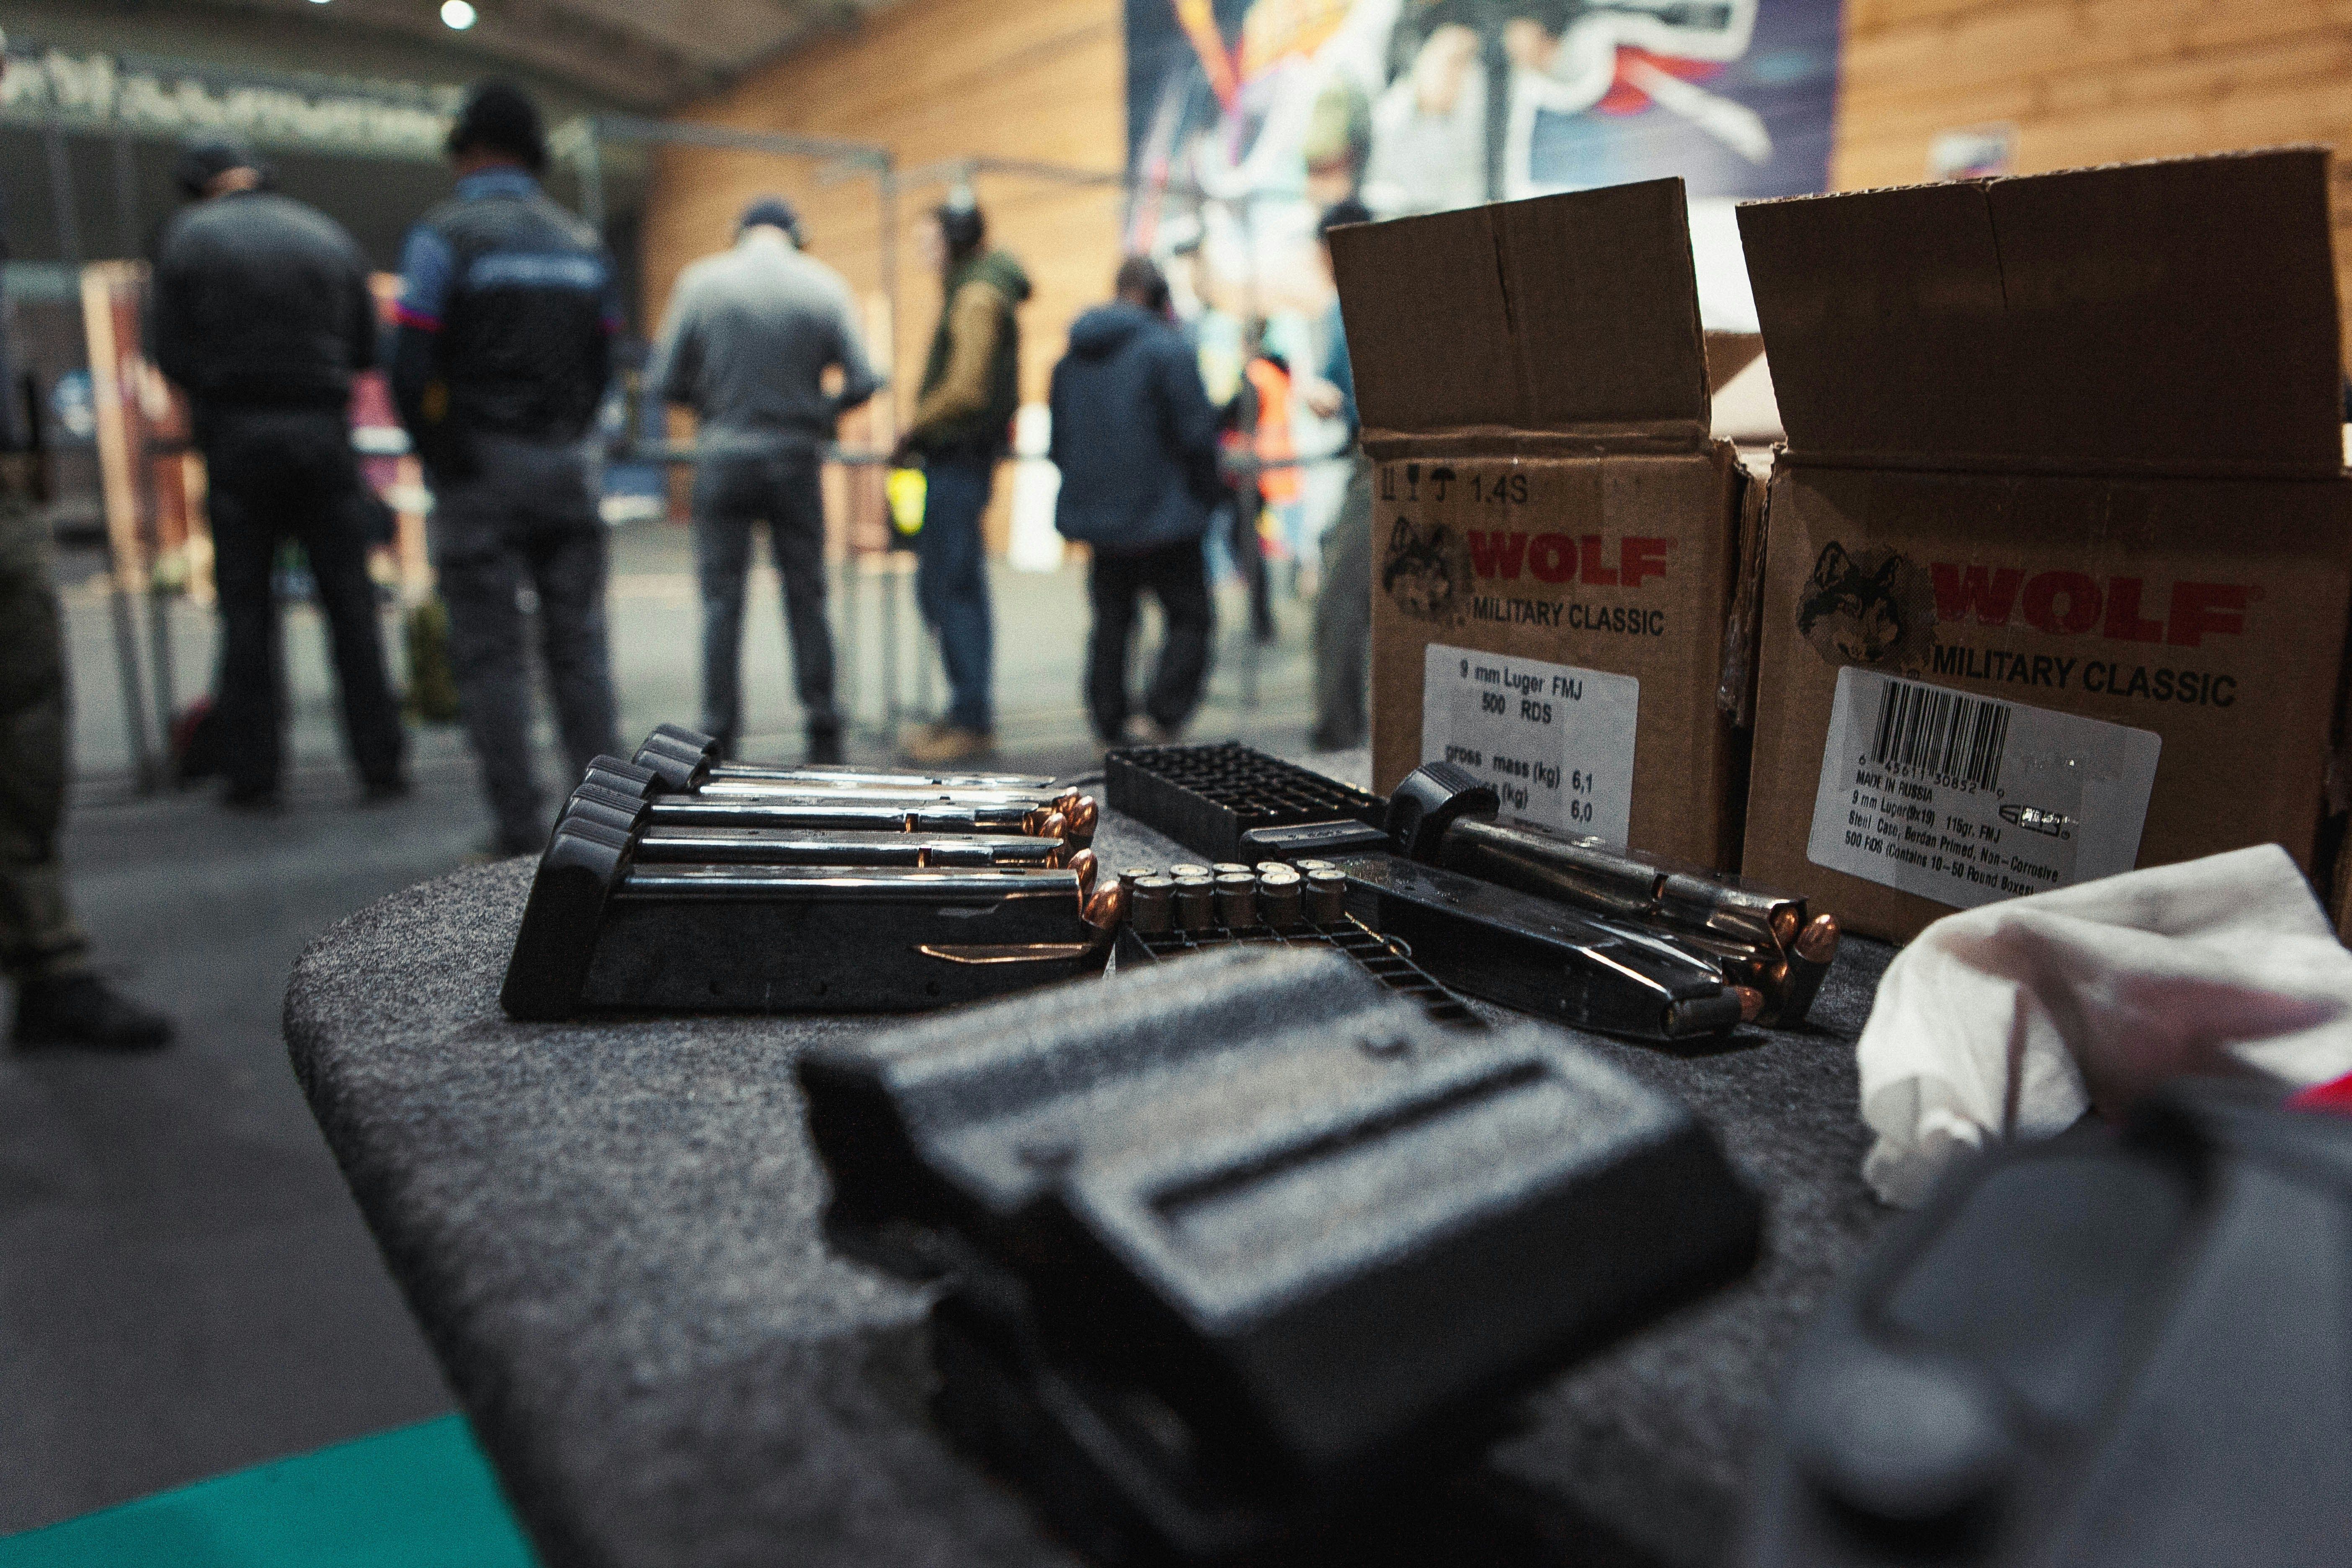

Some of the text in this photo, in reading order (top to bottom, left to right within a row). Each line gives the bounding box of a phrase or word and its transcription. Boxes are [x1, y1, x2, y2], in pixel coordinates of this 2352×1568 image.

[1470, 474, 1528, 504] 1.4S
[1467, 529, 1666, 588] WOLF
[1473, 596, 1665, 637] MILITARY CLASSIC
[1930, 562, 2250, 647] WOLF
[1460, 659, 1583, 701] 9 mm Luger FMJ
[1932, 645, 2237, 708] MILITARY CLASSIC
[1482, 690, 1552, 724] 500 RDS
[1493, 755, 1529, 778] mass
[1533, 761, 1561, 789] (kg)
[1572, 769, 1593, 794] 6,1
[1856, 769, 1933, 803] MADE IN RUSSIA
[1885, 760, 1925, 781] 45611
[1933, 773, 1977, 794] 30852
[1502, 781, 1529, 810] (kg)
[1571, 799, 1593, 823] 6,0
[1852, 789, 1859, 805] 9
[1861, 794, 1877, 810] mm
[1946, 815, 1975, 838] 115gr.
[1979, 824, 2001, 844] FMJ
[1849, 810, 1872, 830] Steel
[1877, 818, 1901, 840] Case,
[1905, 826, 1937, 848] Berdan
[1940, 836, 1976, 862] Primed,
[1845, 830, 1862, 848] 500
[1864, 836, 1884, 854] RDS
[1885, 841, 1928, 868] (Contains
[1967, 866, 1999, 887] Round
